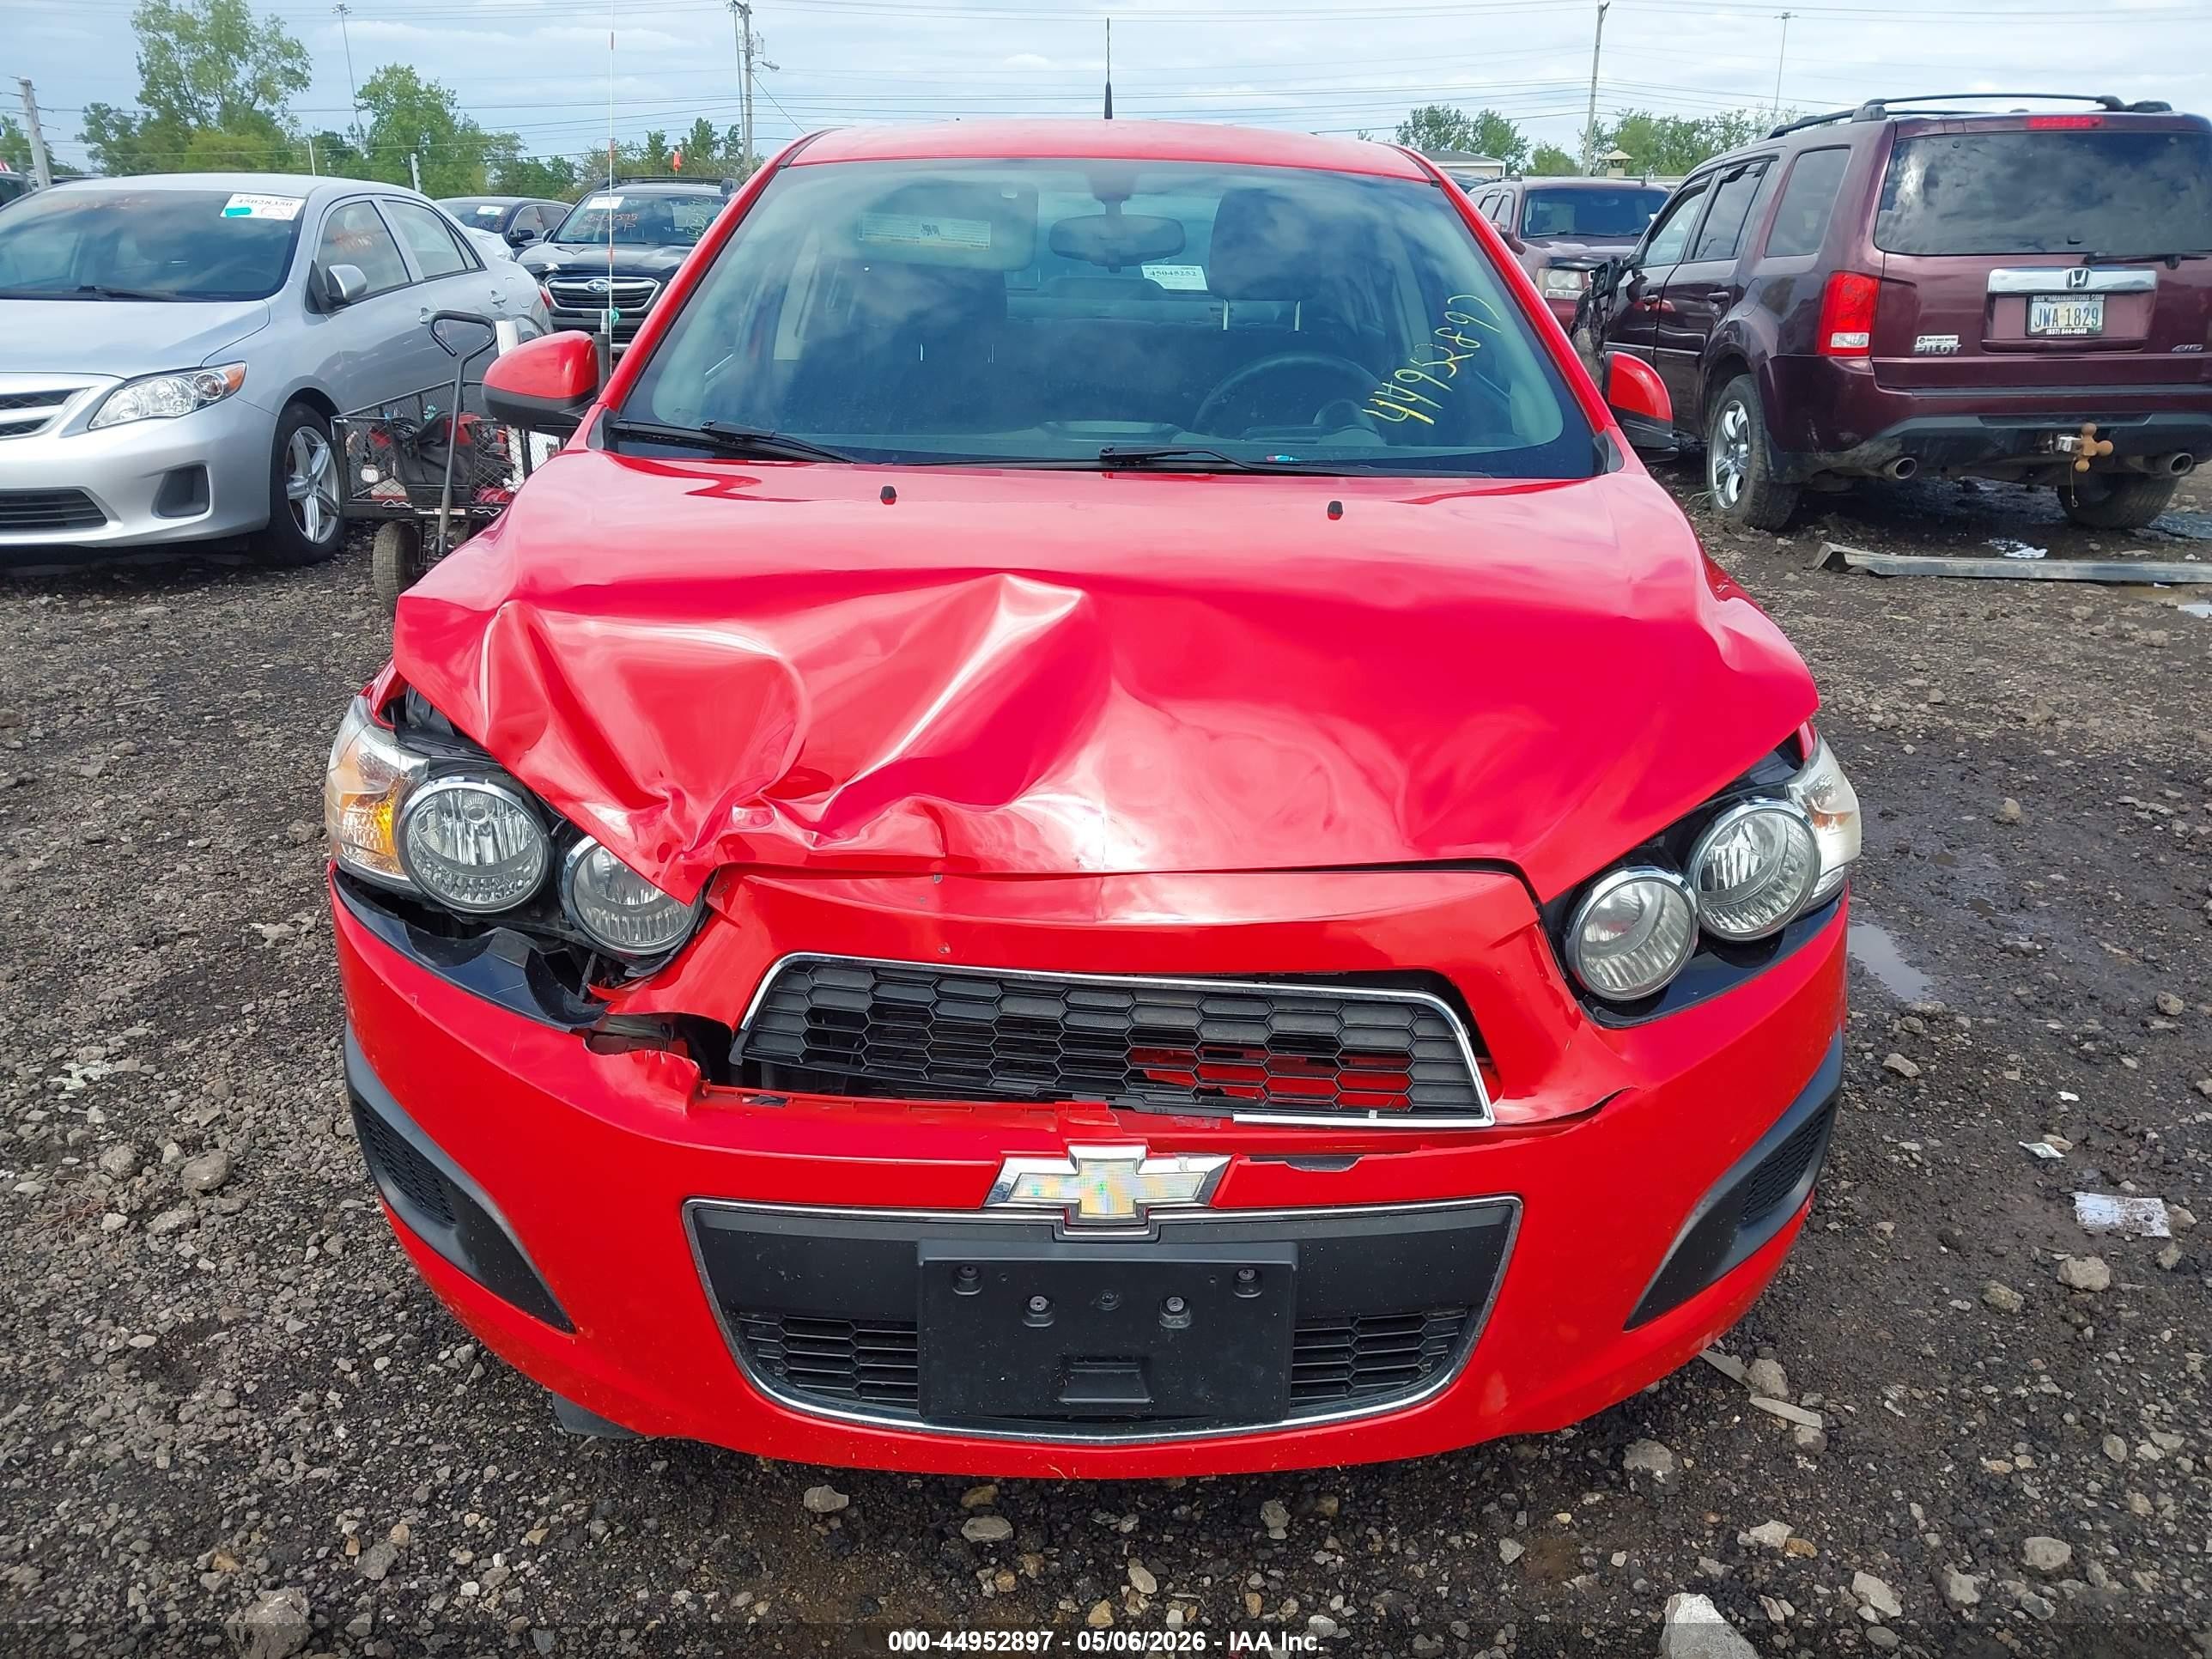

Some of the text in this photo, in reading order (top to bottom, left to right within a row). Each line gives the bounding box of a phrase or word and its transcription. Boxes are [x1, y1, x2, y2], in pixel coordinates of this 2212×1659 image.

[2034, 307, 2099, 327] JWA 1829
[1915, 343, 1961, 355] PILOT
[2172, 343, 2203, 352] 4WD
